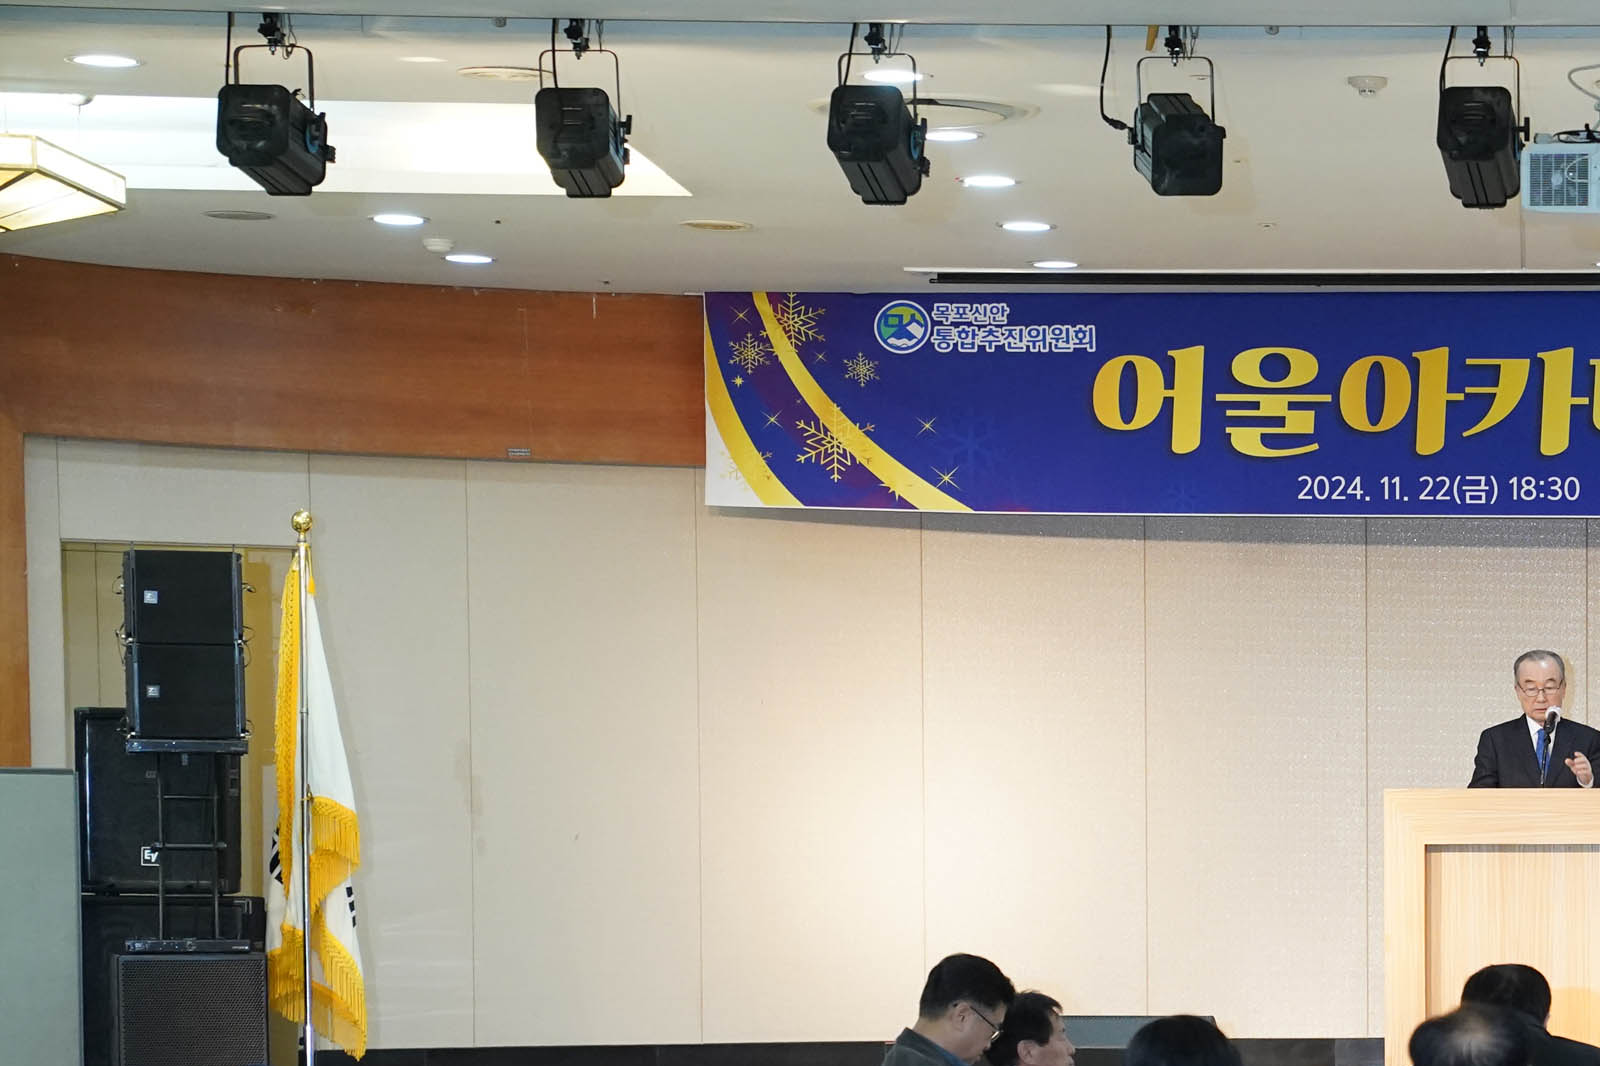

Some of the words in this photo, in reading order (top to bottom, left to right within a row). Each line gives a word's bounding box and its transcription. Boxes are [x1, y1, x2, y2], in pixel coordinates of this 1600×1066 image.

[932, 303, 1010, 325] 목포신안
[931, 325, 1097, 353] 통합추진위원회
[1297, 475, 1371, 502] 2024.
[1380, 475, 1410, 502] 11.
[1419, 475, 1498, 505] 22(금)
[1509, 475, 1580, 502] 18:30
